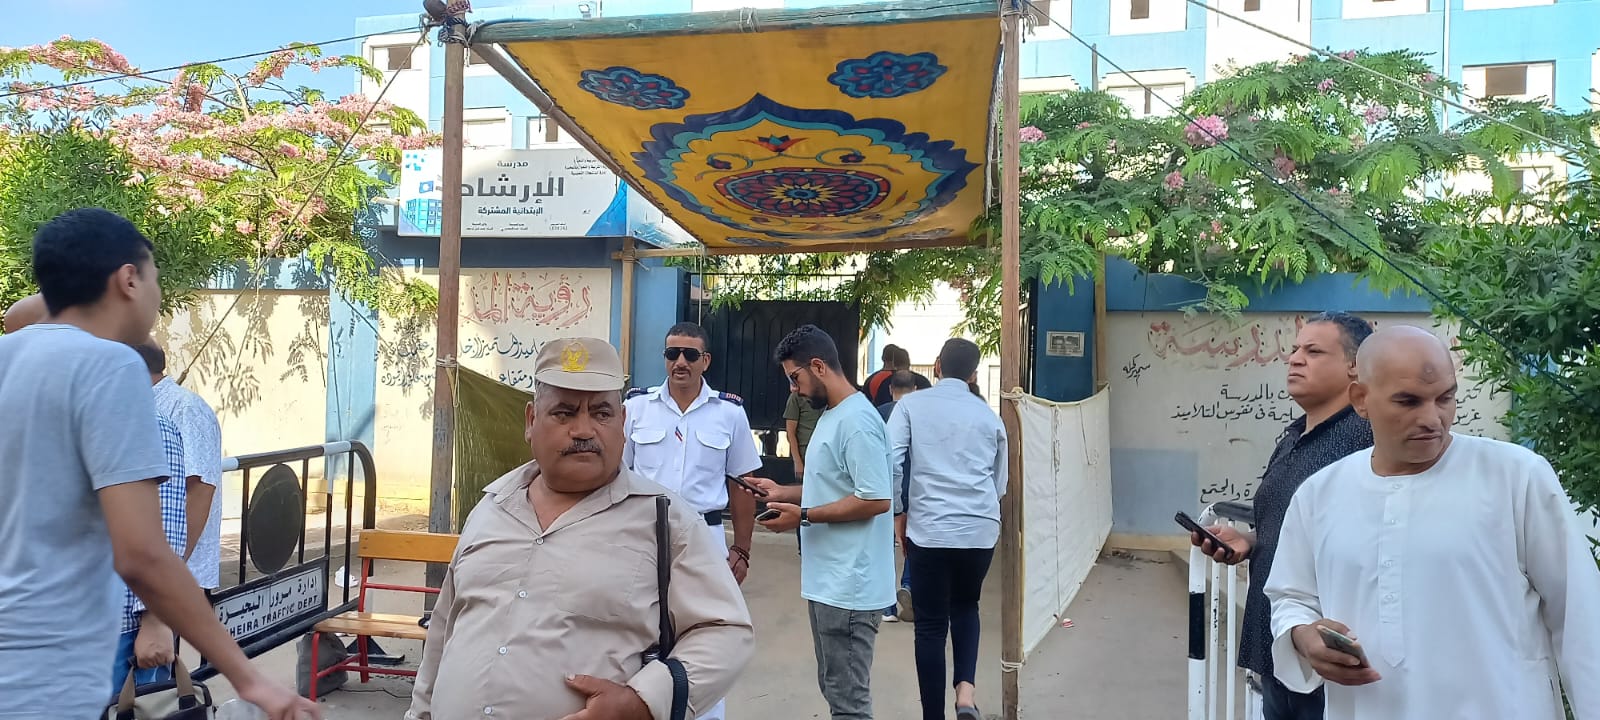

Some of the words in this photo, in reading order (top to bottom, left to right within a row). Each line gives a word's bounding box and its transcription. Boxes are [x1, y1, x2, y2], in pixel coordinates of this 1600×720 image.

[497, 160, 529, 169] مدرسة
[478, 206, 511, 216] المشتركة
[1220, 383, 1274, 403] بالمدرسة
[1170, 401, 1220, 420] التلاميذ
[270, 586, 292, 607] مرور
[219, 594, 264, 625] البحيرة
[227, 619, 259, 637] HEIRA
[297, 594, 318, 610] DEPT
